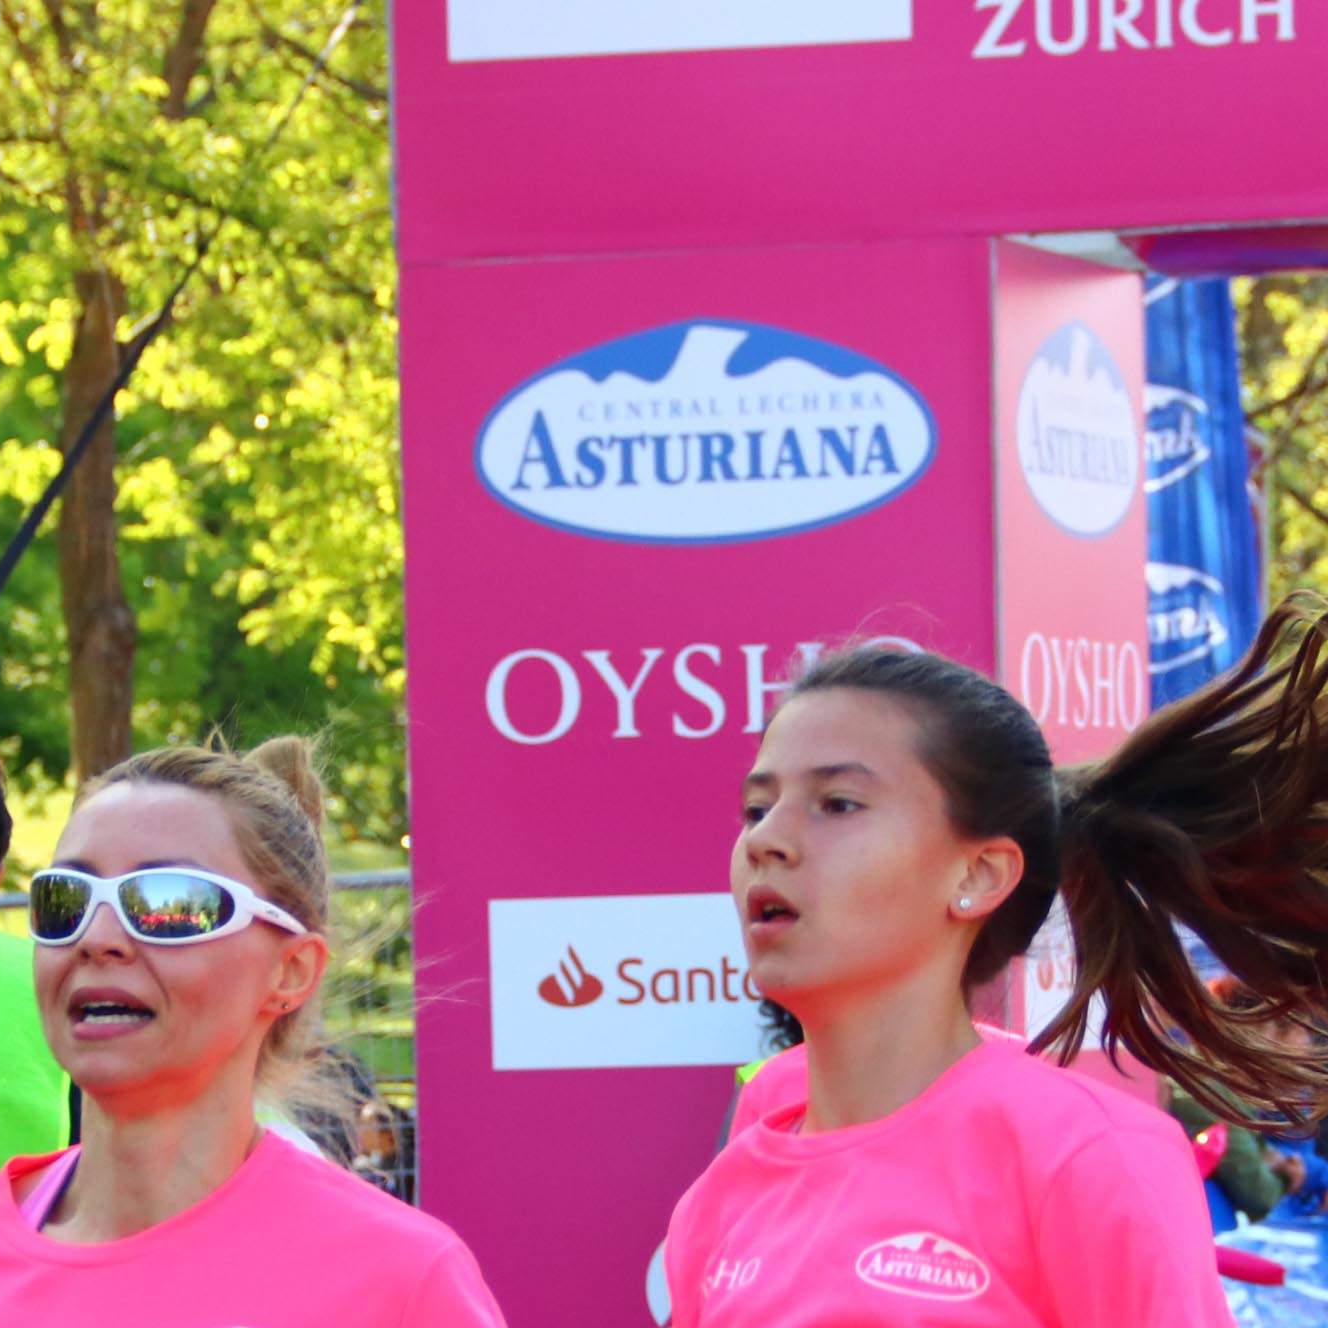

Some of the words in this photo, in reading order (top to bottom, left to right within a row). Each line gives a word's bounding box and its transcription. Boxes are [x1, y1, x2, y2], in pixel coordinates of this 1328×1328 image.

[971, 0, 1296, 59] ZURICH
[579, 400, 723, 423] CENTRAL
[738, 391, 887, 416] LECHERA
[510, 408, 902, 490] ASTURIANA
[485, 636, 925, 744] OYSH
[1022, 631, 1144, 733] OYSHO
[863, 1250, 978, 1290] ASTURIANA
